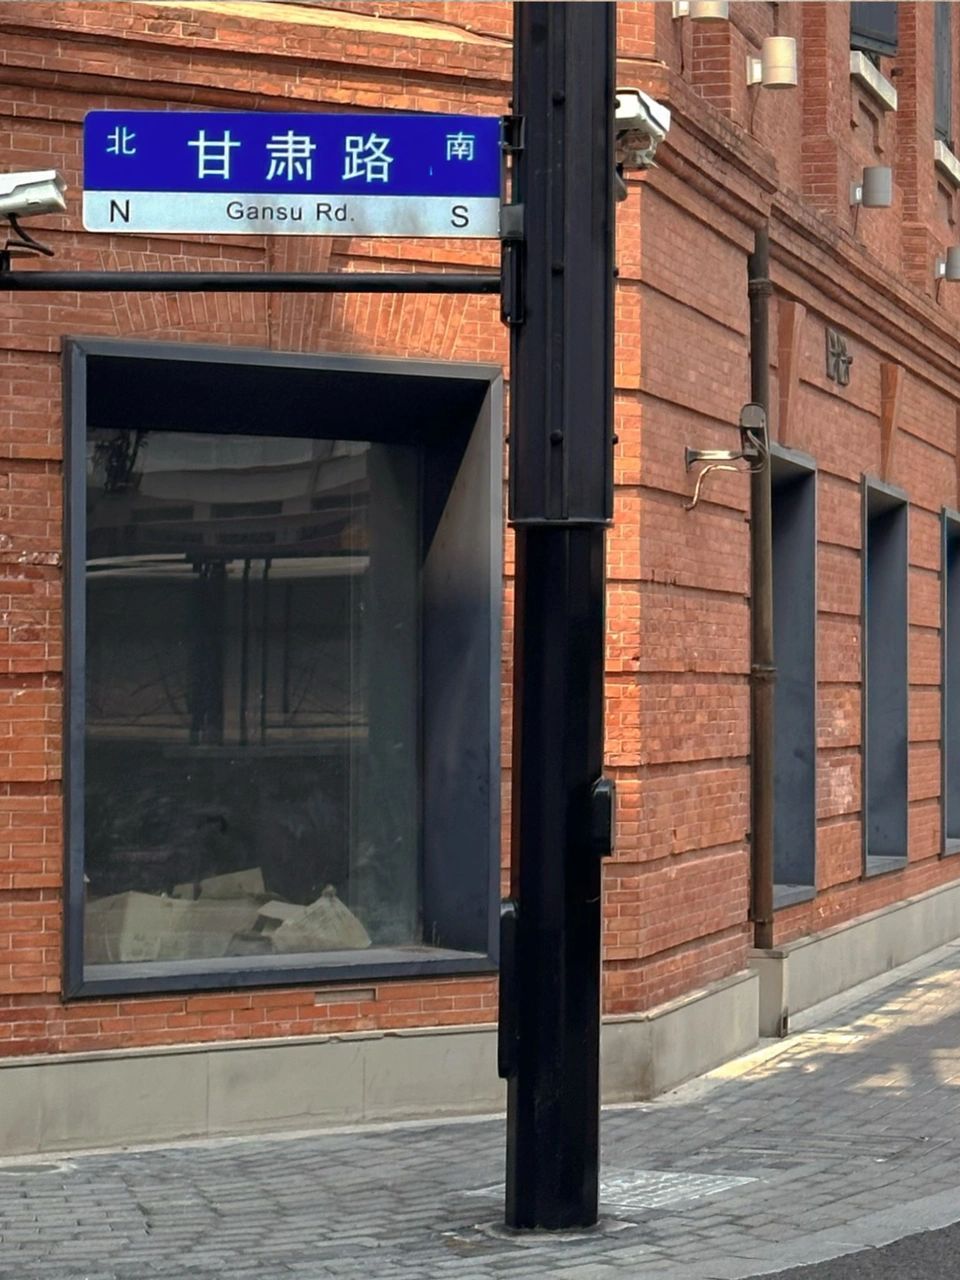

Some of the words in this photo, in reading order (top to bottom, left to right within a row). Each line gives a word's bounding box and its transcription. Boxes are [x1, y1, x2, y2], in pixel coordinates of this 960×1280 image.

[106, 126, 137, 156] 北
[187, 129, 394, 183] 甘肃路
[446, 131, 476, 161] 南
[110, 200, 131, 223] N
[226, 201, 303, 222] Gansu
[316, 203, 355, 222] Rd.
[450, 206, 470, 228] S
